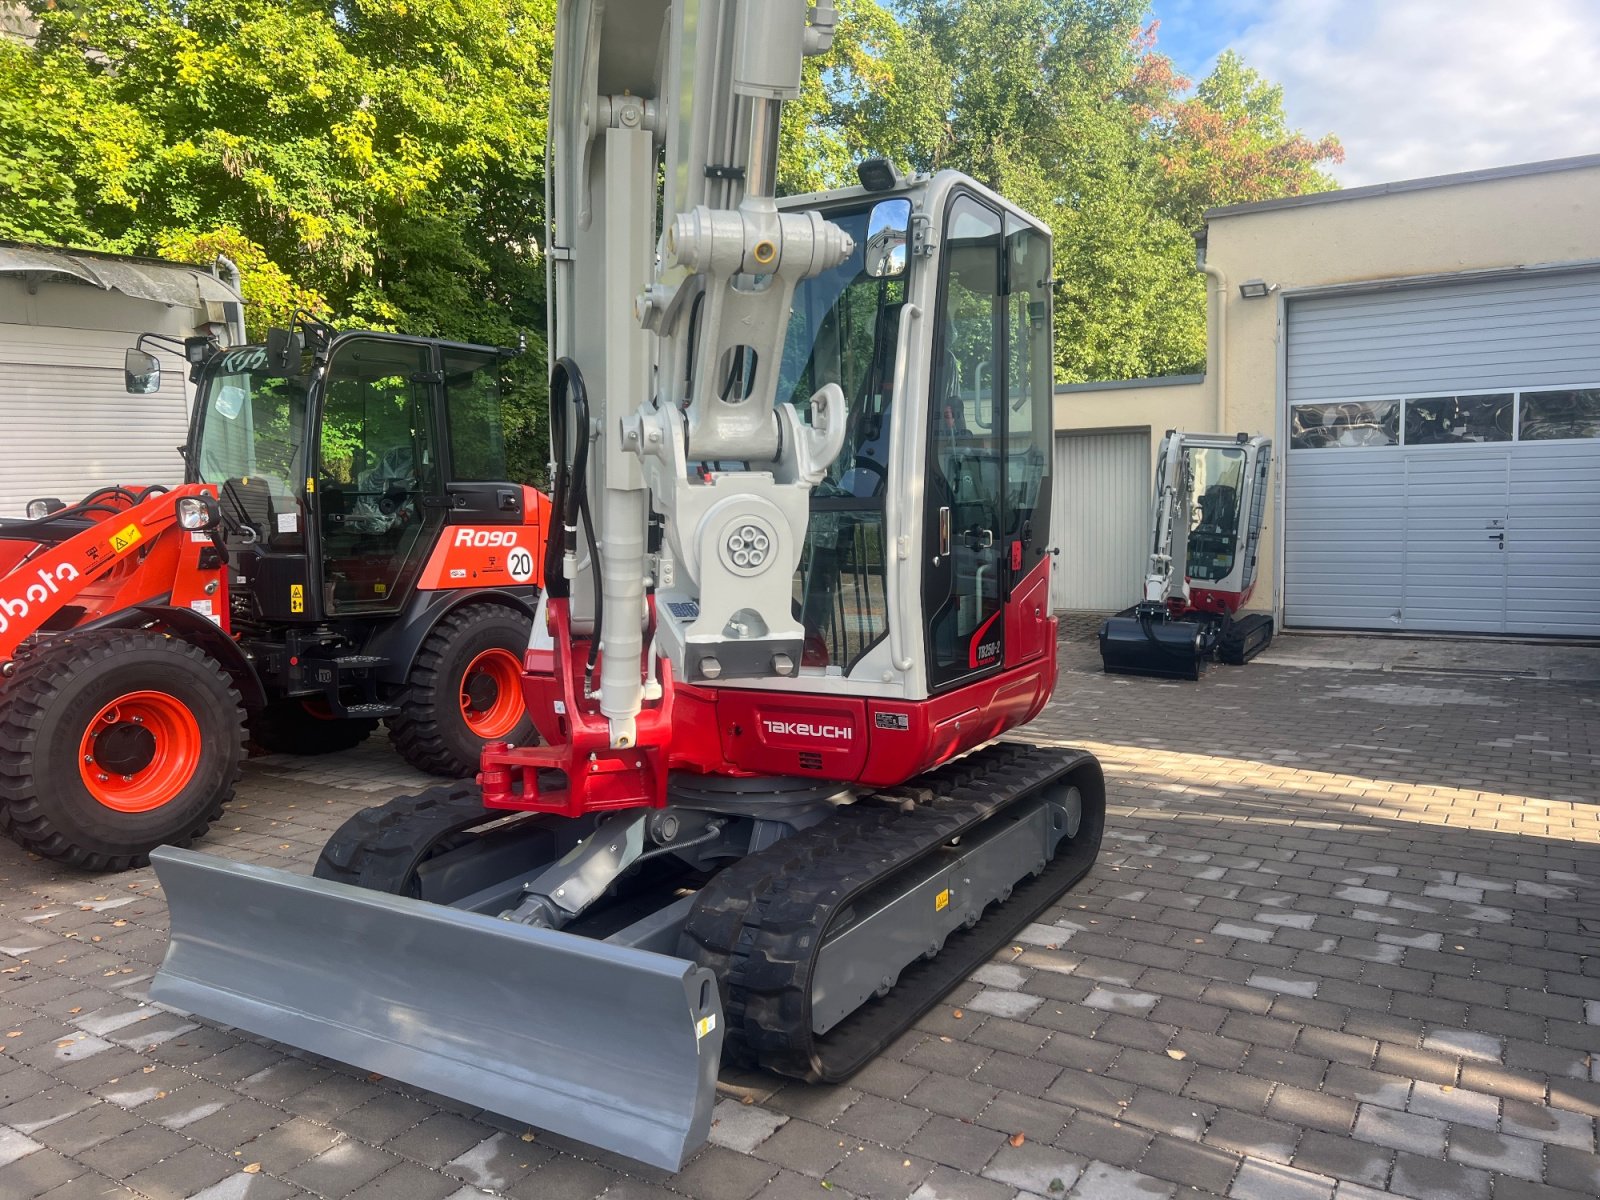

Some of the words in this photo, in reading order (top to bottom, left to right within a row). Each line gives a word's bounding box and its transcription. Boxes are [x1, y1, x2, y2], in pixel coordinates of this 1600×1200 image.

[221, 347, 268, 373] Kub
[454, 528, 517, 547] R090
[511, 553, 530, 575] 20
[763, 720, 852, 740] TAKEUCHI
